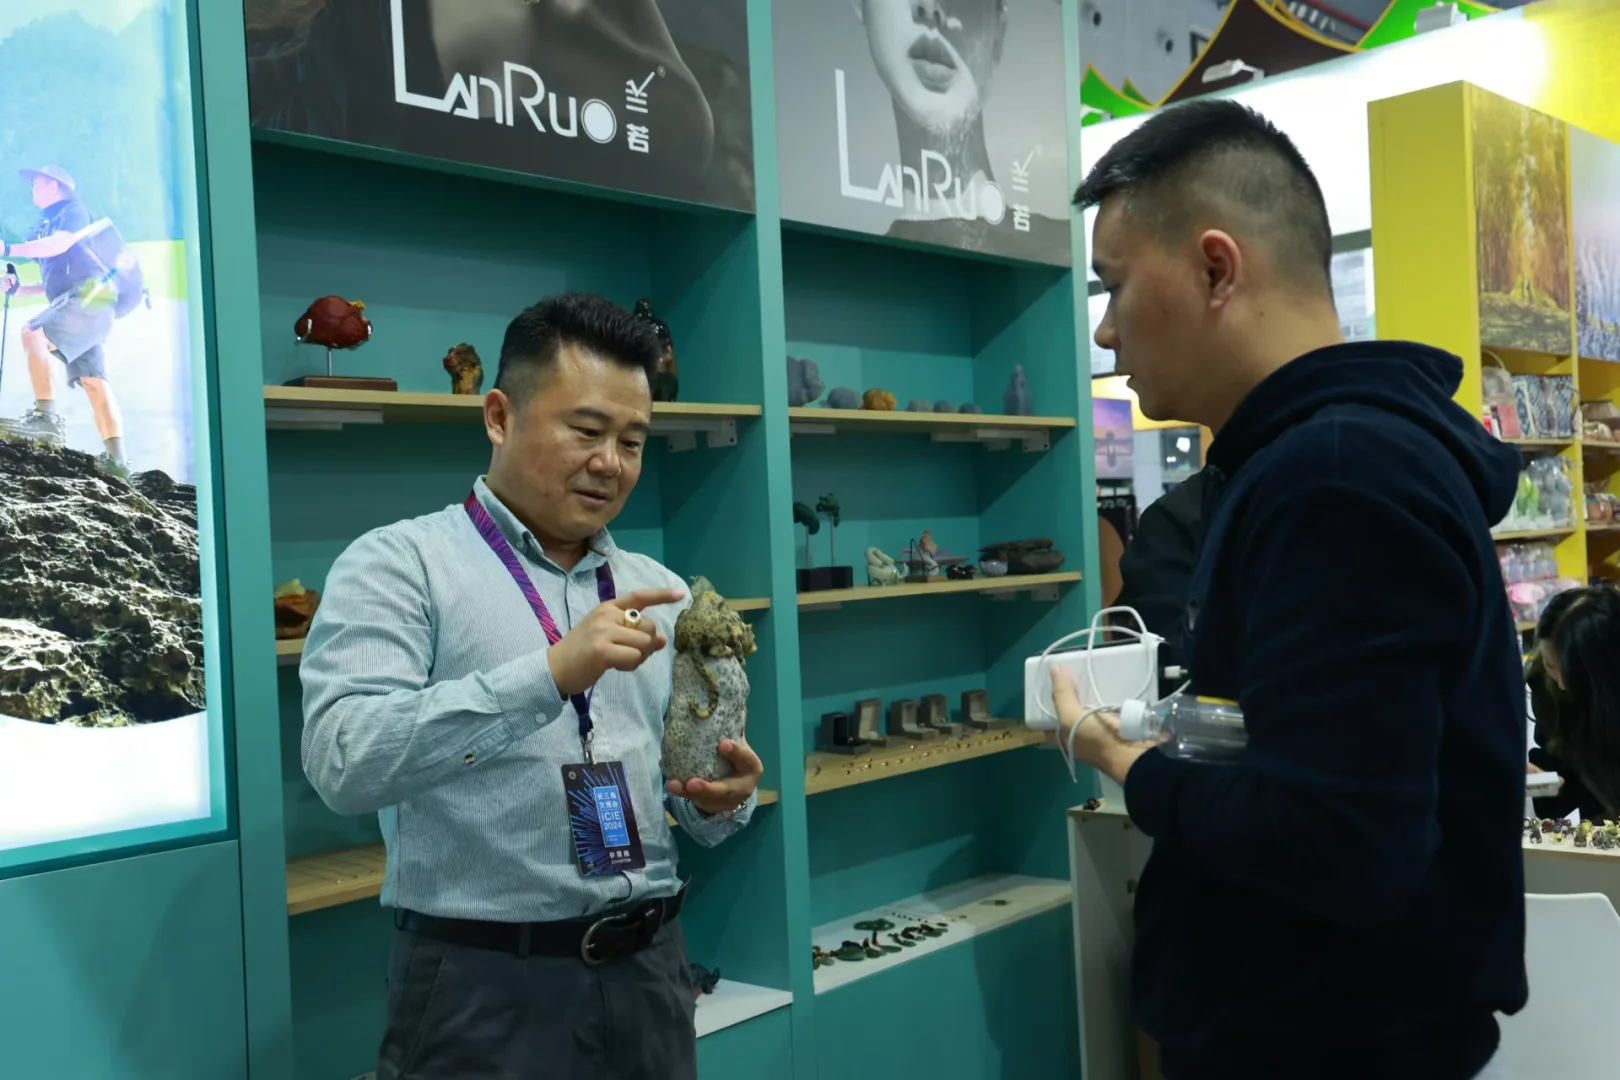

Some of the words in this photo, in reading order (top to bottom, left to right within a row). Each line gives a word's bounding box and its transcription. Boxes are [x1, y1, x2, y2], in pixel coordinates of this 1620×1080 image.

[597, 791, 617, 800] 长三角
[604, 822, 623, 831] 2024
